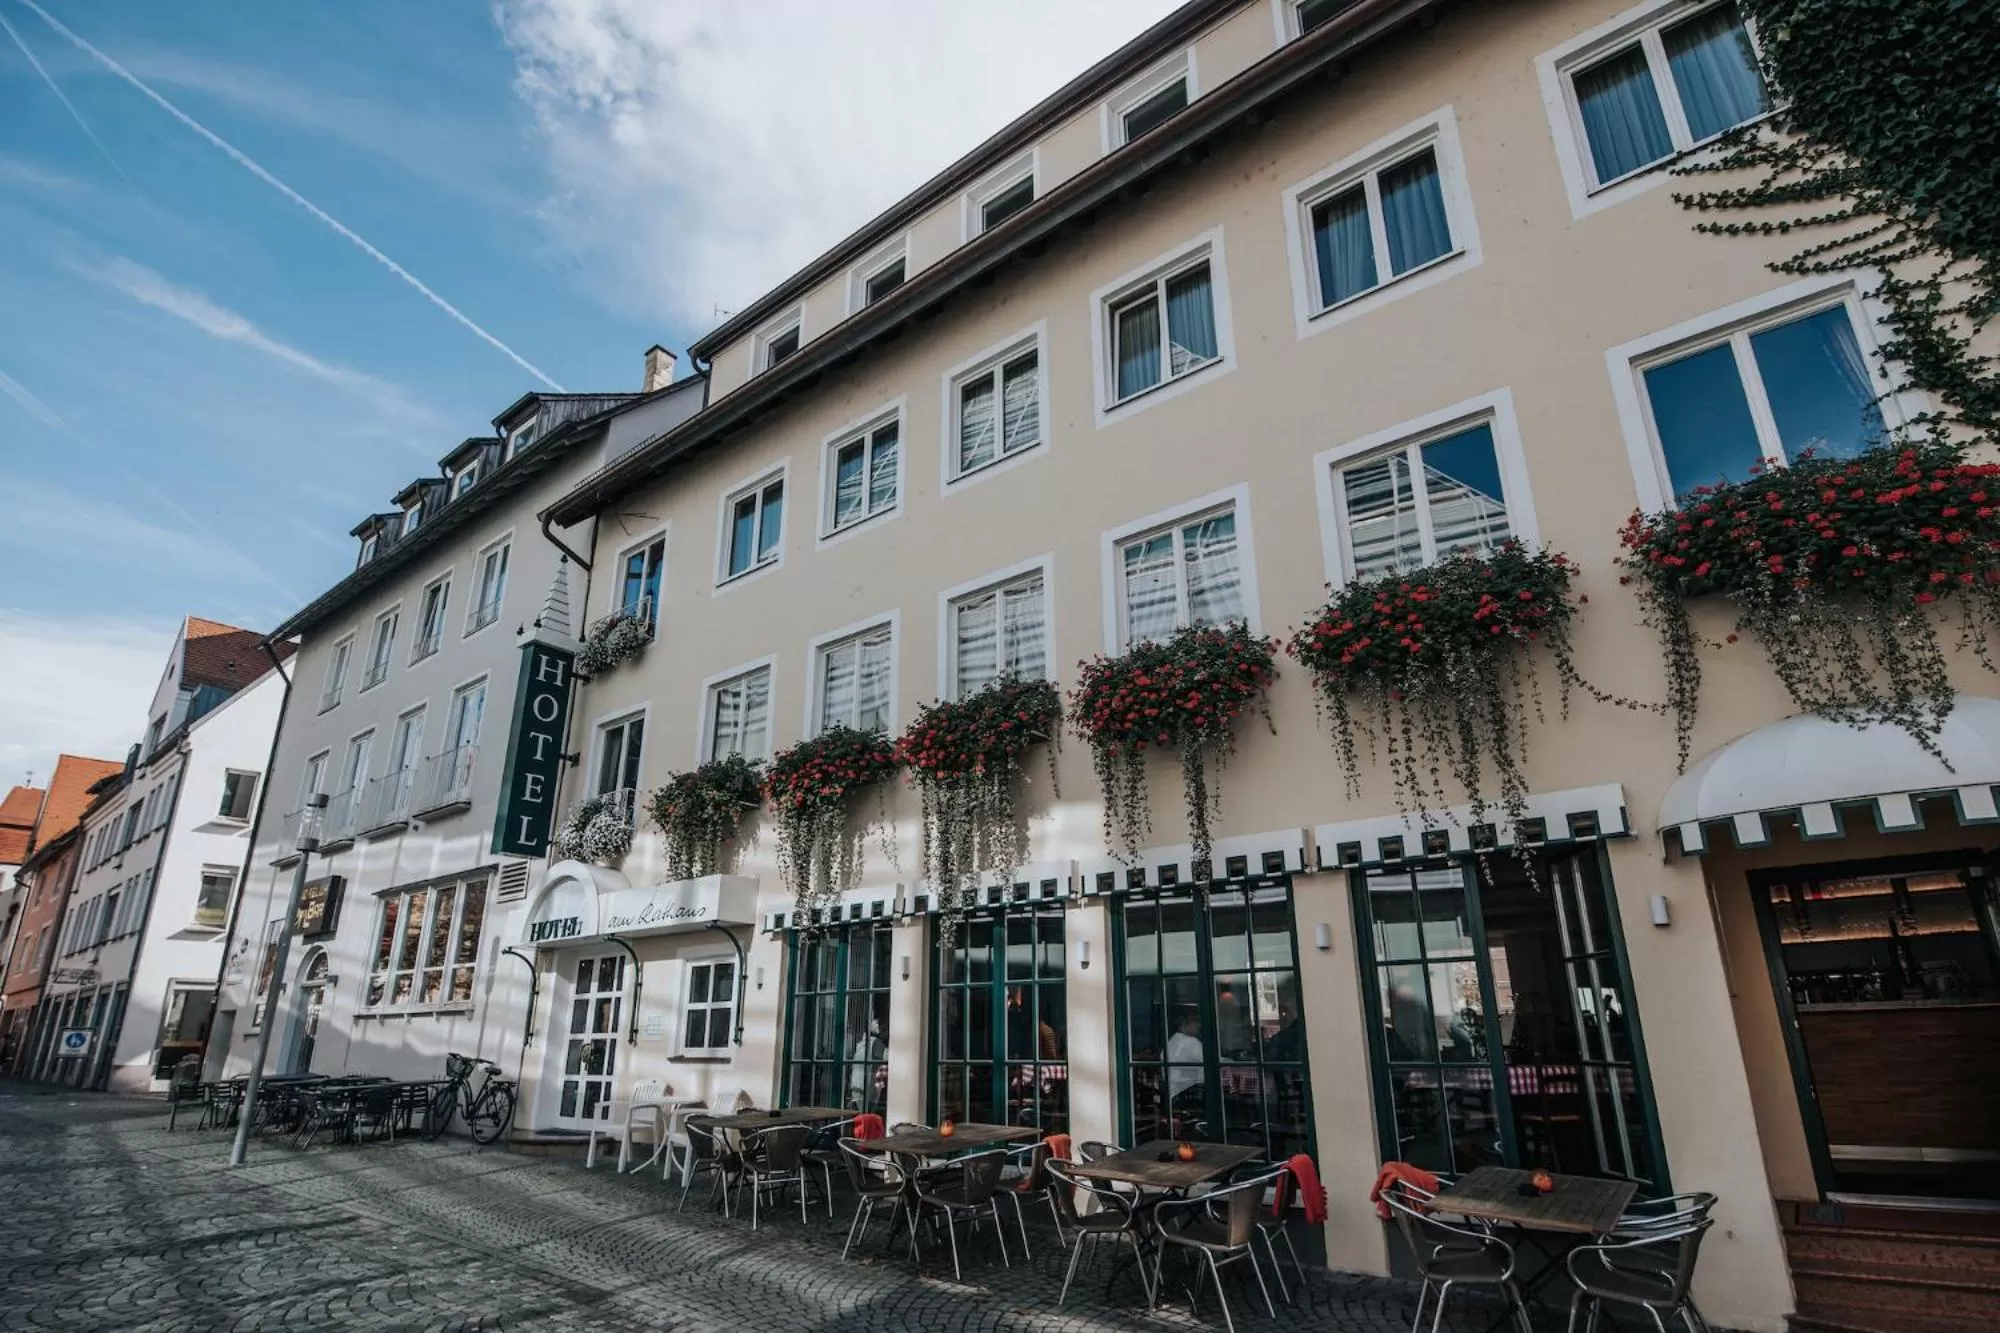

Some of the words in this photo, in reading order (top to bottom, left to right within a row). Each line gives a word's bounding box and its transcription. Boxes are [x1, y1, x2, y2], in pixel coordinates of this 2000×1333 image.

[516, 653, 567, 846] HOTEL
[637, 901, 706, 925] Rathaus
[529, 916, 583, 942] HOTEL
